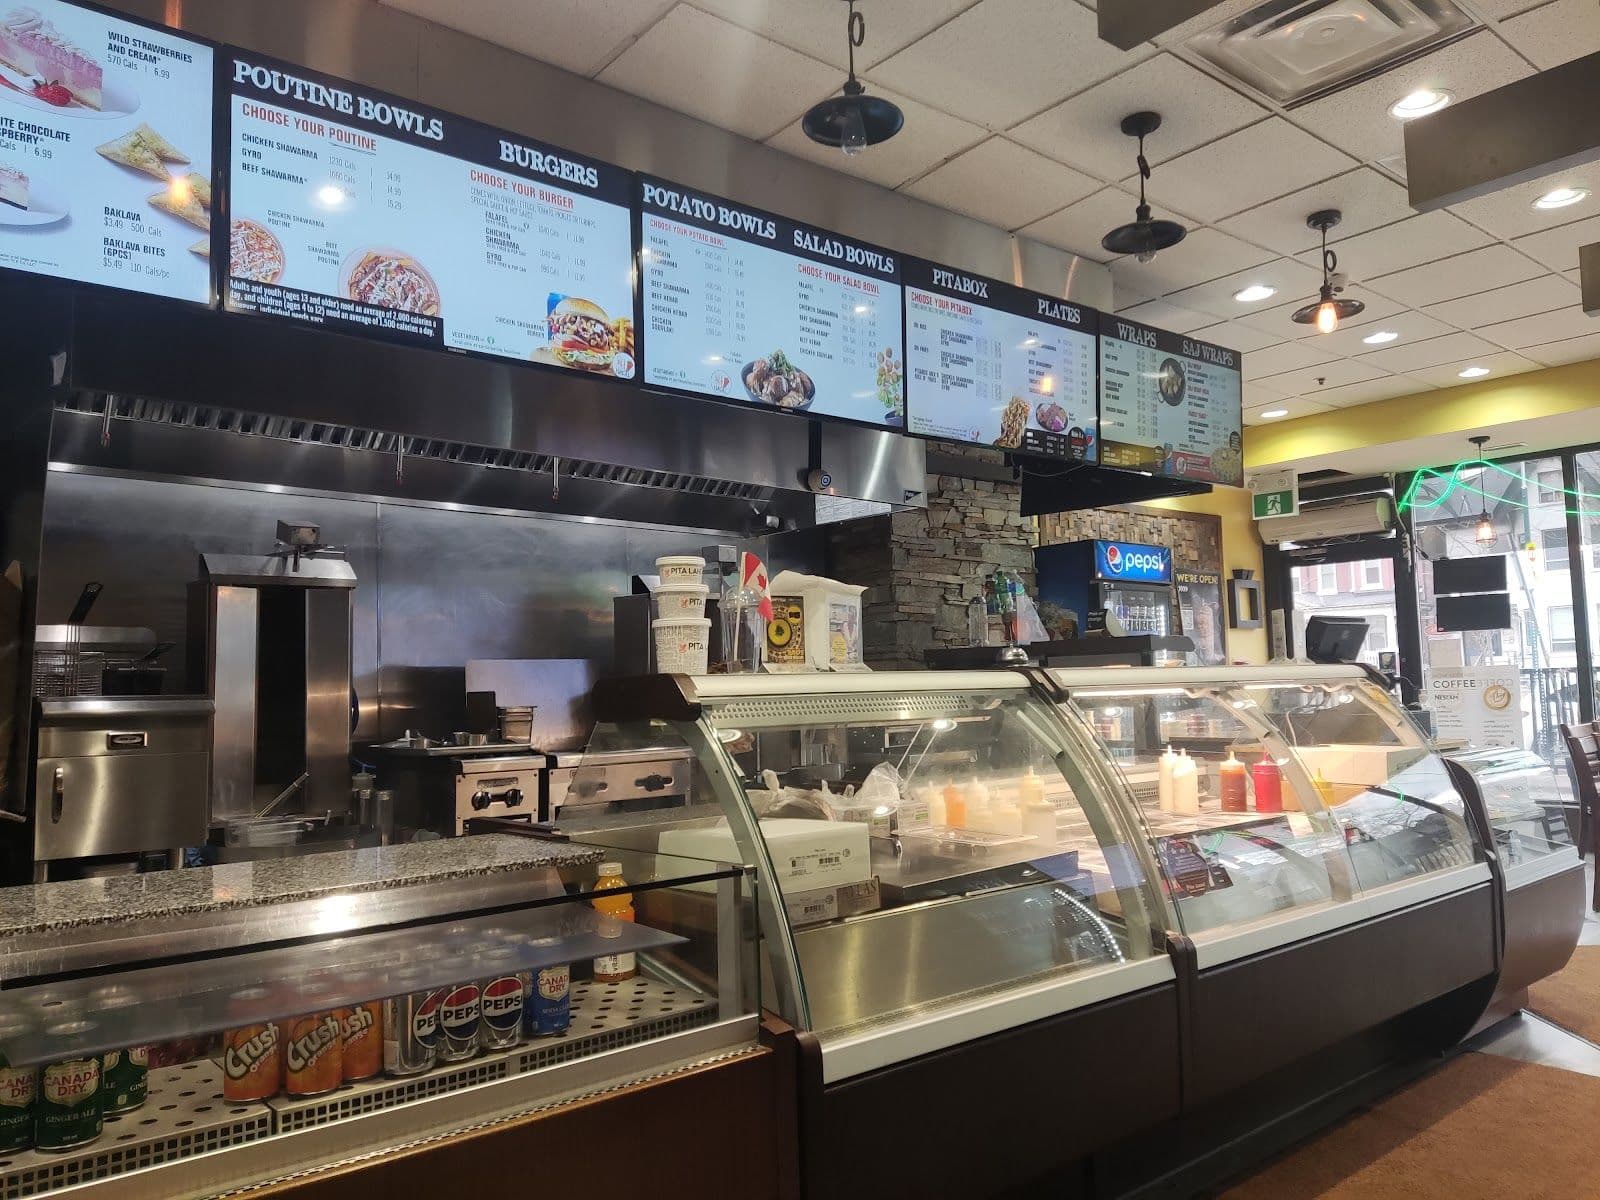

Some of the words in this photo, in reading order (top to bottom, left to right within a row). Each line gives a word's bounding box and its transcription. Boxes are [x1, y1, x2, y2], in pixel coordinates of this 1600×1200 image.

[107, 31, 130, 45] WILD
[132, 38, 193, 64] STRAWBERRIES
[107, 42, 126, 55] AND
[107, 53, 122, 66] 570
[123, 58, 138, 70] Cals
[154, 67, 170, 79] 6.99
[233, 59, 353, 115] POUTINE
[357, 96, 444, 141] BOWLS
[0, 116, 14, 129] ITE
[18, 121, 71, 142] CHOCOLATE
[242, 103, 290, 128] CHOOSE
[294, 116, 325, 137] YOUR
[329, 128, 377, 151] POUTINE
[34, 147, 52, 159] 6.99
[242, 133, 274, 149] CHICKEN
[276, 141, 319, 160] SHAWARMA
[242, 148, 262, 161] GYRO
[242, 162, 259, 173] BEEF
[499, 140, 598, 189] BURGERS
[470, 169, 508, 190] CHOOSE
[511, 182, 536, 198] YOUR
[539, 189, 574, 209] BURGER
[104, 206, 141, 222] BAKLAVA
[267, 209, 291, 221] CHICKEN
[485, 211, 508, 224] FALAFEL
[643, 183, 716, 221] POTATO
[718, 206, 777, 239] BOWLS
[104, 216, 124, 230] $3.49
[131, 222, 145, 234] 500
[148, 226, 162, 237] Cals
[267, 217, 291, 229] POUTINE
[649, 219, 671, 232] CHOOSE
[672, 225, 688, 238] YOUR
[485, 227, 511, 240] CHICKEN
[485, 235, 520, 250] SHAWARMA
[103, 237, 140, 253] BAKLAVA
[143, 245, 166, 257] BITES
[103, 246, 132, 261] (6PCS)
[487, 251, 502, 262] GYRO
[794, 229, 844, 260] SALAD
[846, 246, 894, 274] BOWLS
[103, 257, 123, 270] $5.49
[798, 264, 822, 279] CHOOSE
[825, 272, 841, 283] YOUR
[843, 276, 861, 289] SALAD
[863, 281, 880, 294] BOWL
[932, 267, 989, 299] PITABOX
[229, 279, 250, 292] Adults
[251, 284, 263, 293] and
[264, 287, 282, 298] youth
[283, 290, 300, 301] (ages
[301, 292, 309, 302] 13
[309, 296, 321, 304] and
[363, 307, 385, 318] average
[244, 293, 256, 302] and
[257, 296, 282, 307] children
[283, 299, 300, 311] (ages
[307, 304, 314, 313] to
[911, 291, 932, 306] CHOOSE
[935, 298, 949, 310] YOUR
[950, 303, 972, 316] PITABOX
[1037, 298, 1081, 325] PLATES
[1117, 322, 1157, 348] WRAPS
[1182, 340, 1200, 357] SAJ
[1202, 344, 1233, 367] WRAPS
[1125, 552, 1164, 573] pepsi
[688, 642, 704, 651] PITA
[1433, 679, 1476, 689] COFFEE
[443, 1003, 480, 1022] PEPS
[483, 995, 520, 1011] PEPS
[341, 1006, 373, 1039] ush
[225, 1022, 280, 1079] Crush
[288, 1016, 339, 1072] Crush
[44, 1068, 101, 1087] CANADA
[11, 1086, 31, 1098] DR
